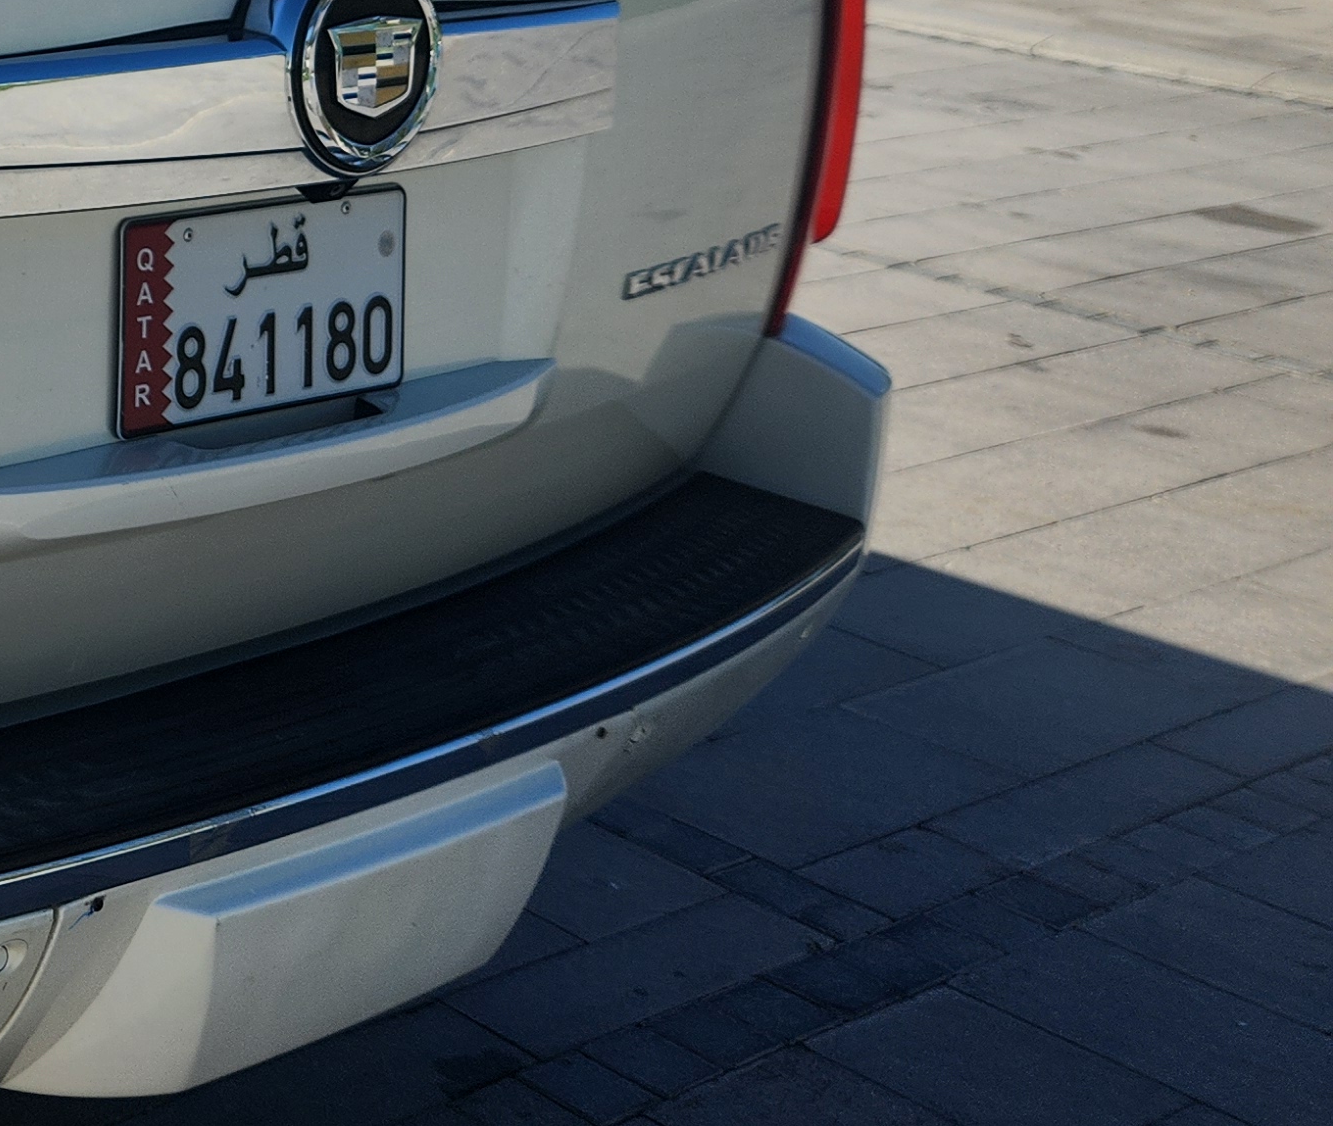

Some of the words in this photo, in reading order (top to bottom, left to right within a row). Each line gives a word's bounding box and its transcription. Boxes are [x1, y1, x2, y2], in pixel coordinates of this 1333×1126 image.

[224, 212, 310, 297] قطر
[134, 247, 155, 408] QATAR
[173, 294, 394, 410] 841180
